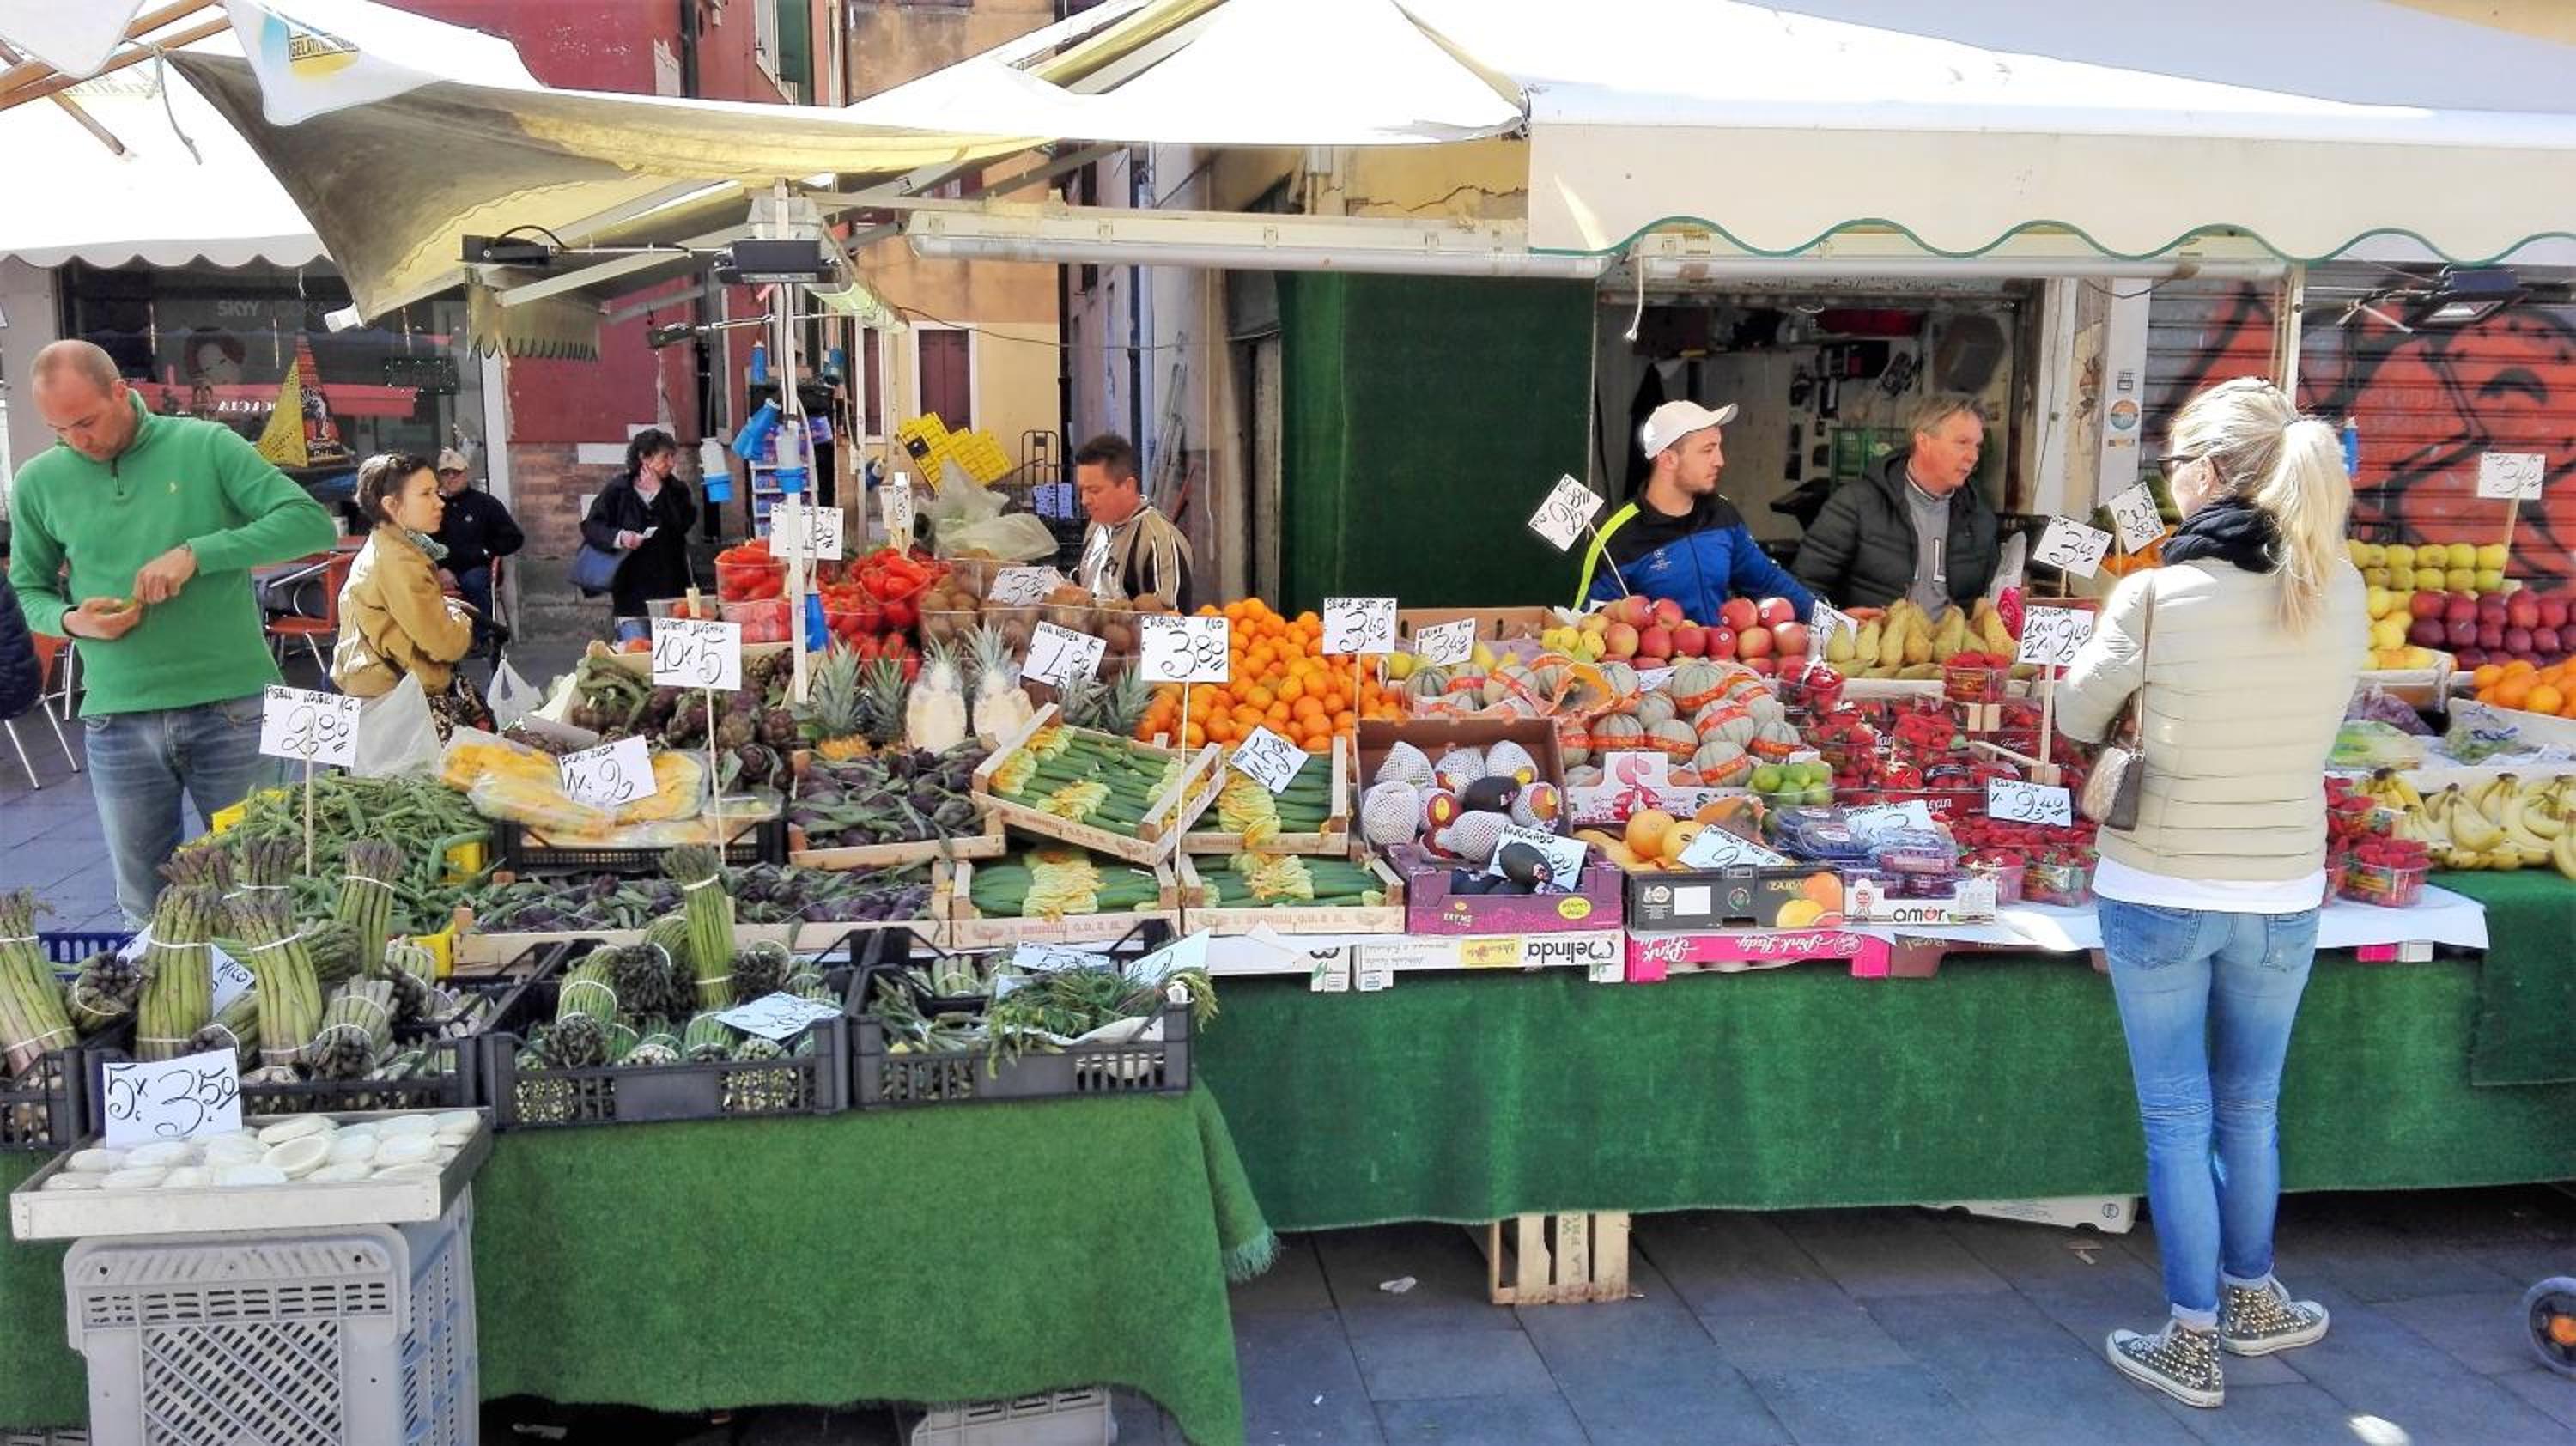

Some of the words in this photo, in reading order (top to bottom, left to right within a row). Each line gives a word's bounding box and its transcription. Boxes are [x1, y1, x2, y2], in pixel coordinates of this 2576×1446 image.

[217, 301, 258, 316] SKYY
[697, 637, 726, 684] 5
[1161, 629, 1226, 679] 3.80
[1528, 939, 1616, 965] Melinda
[154, 1067, 240, 1138] 3.50
